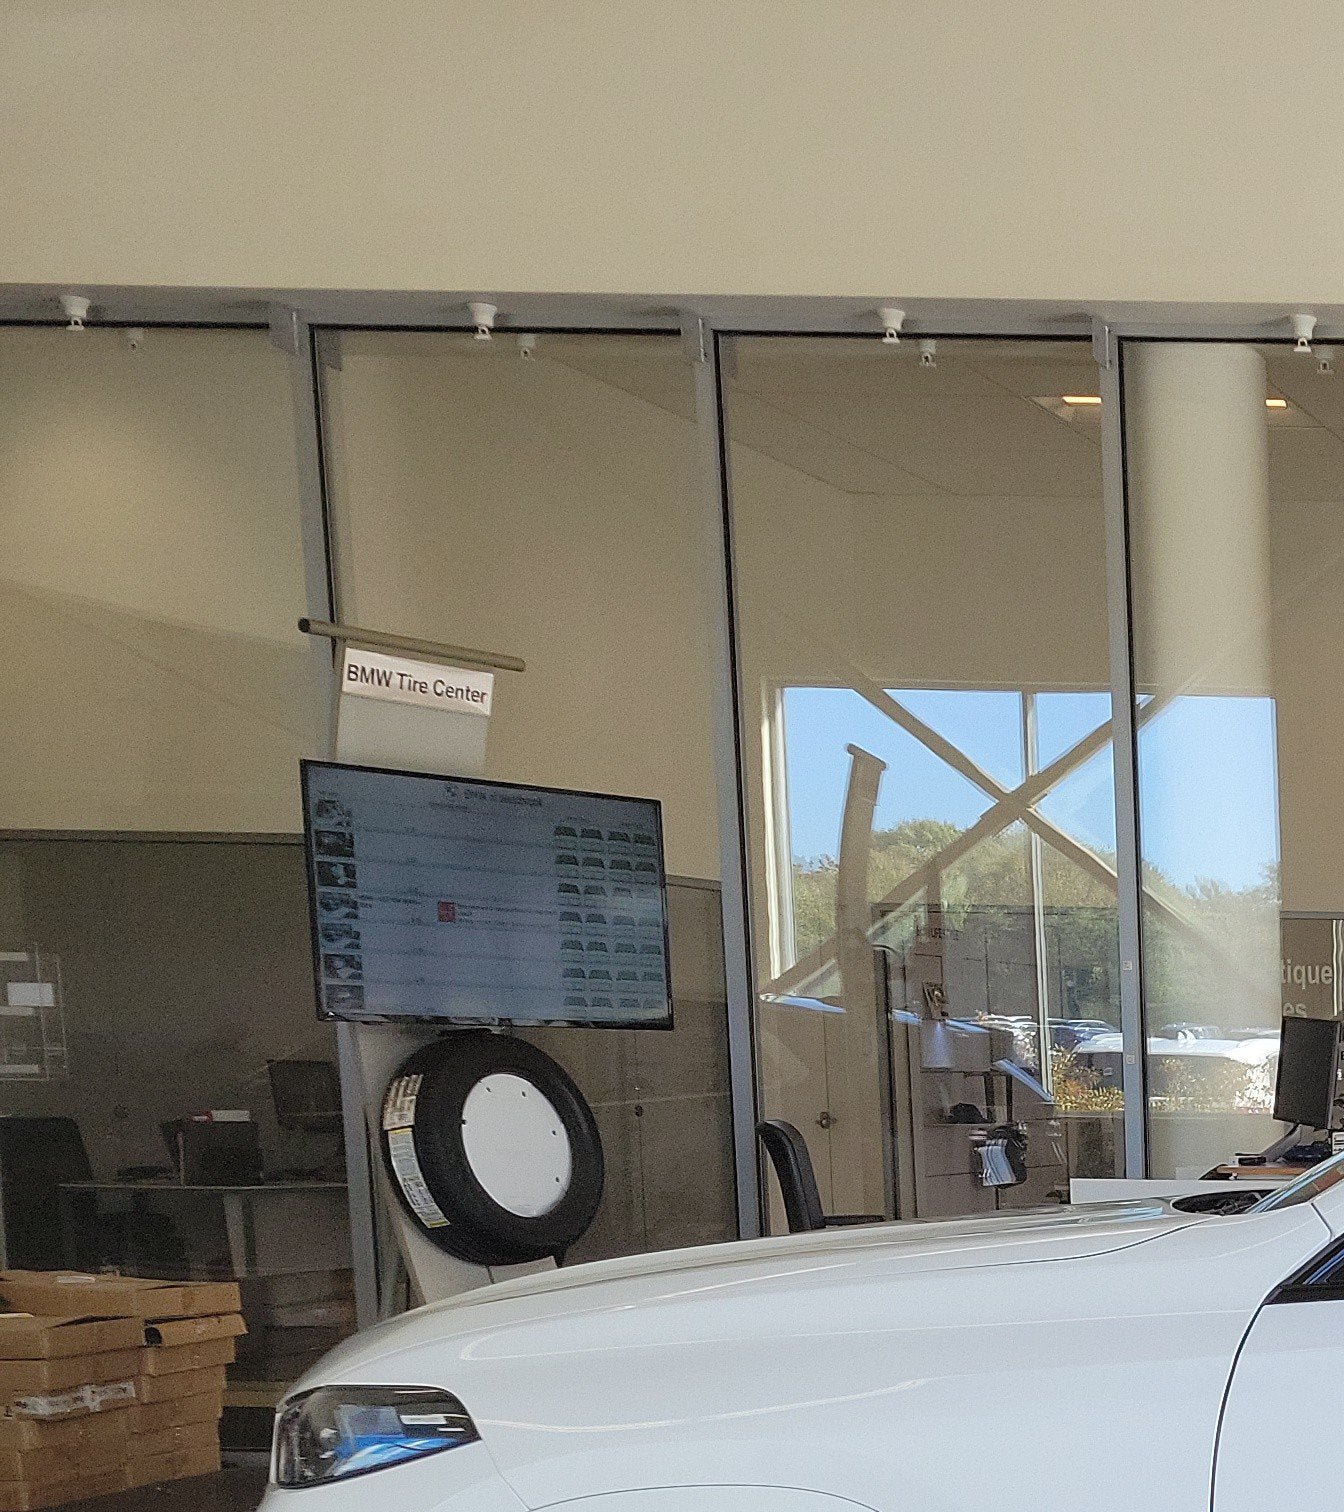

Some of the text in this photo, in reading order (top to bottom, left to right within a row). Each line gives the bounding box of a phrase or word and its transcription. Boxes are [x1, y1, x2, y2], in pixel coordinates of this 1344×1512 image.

[347, 663, 489, 705] BMW Tire Center
